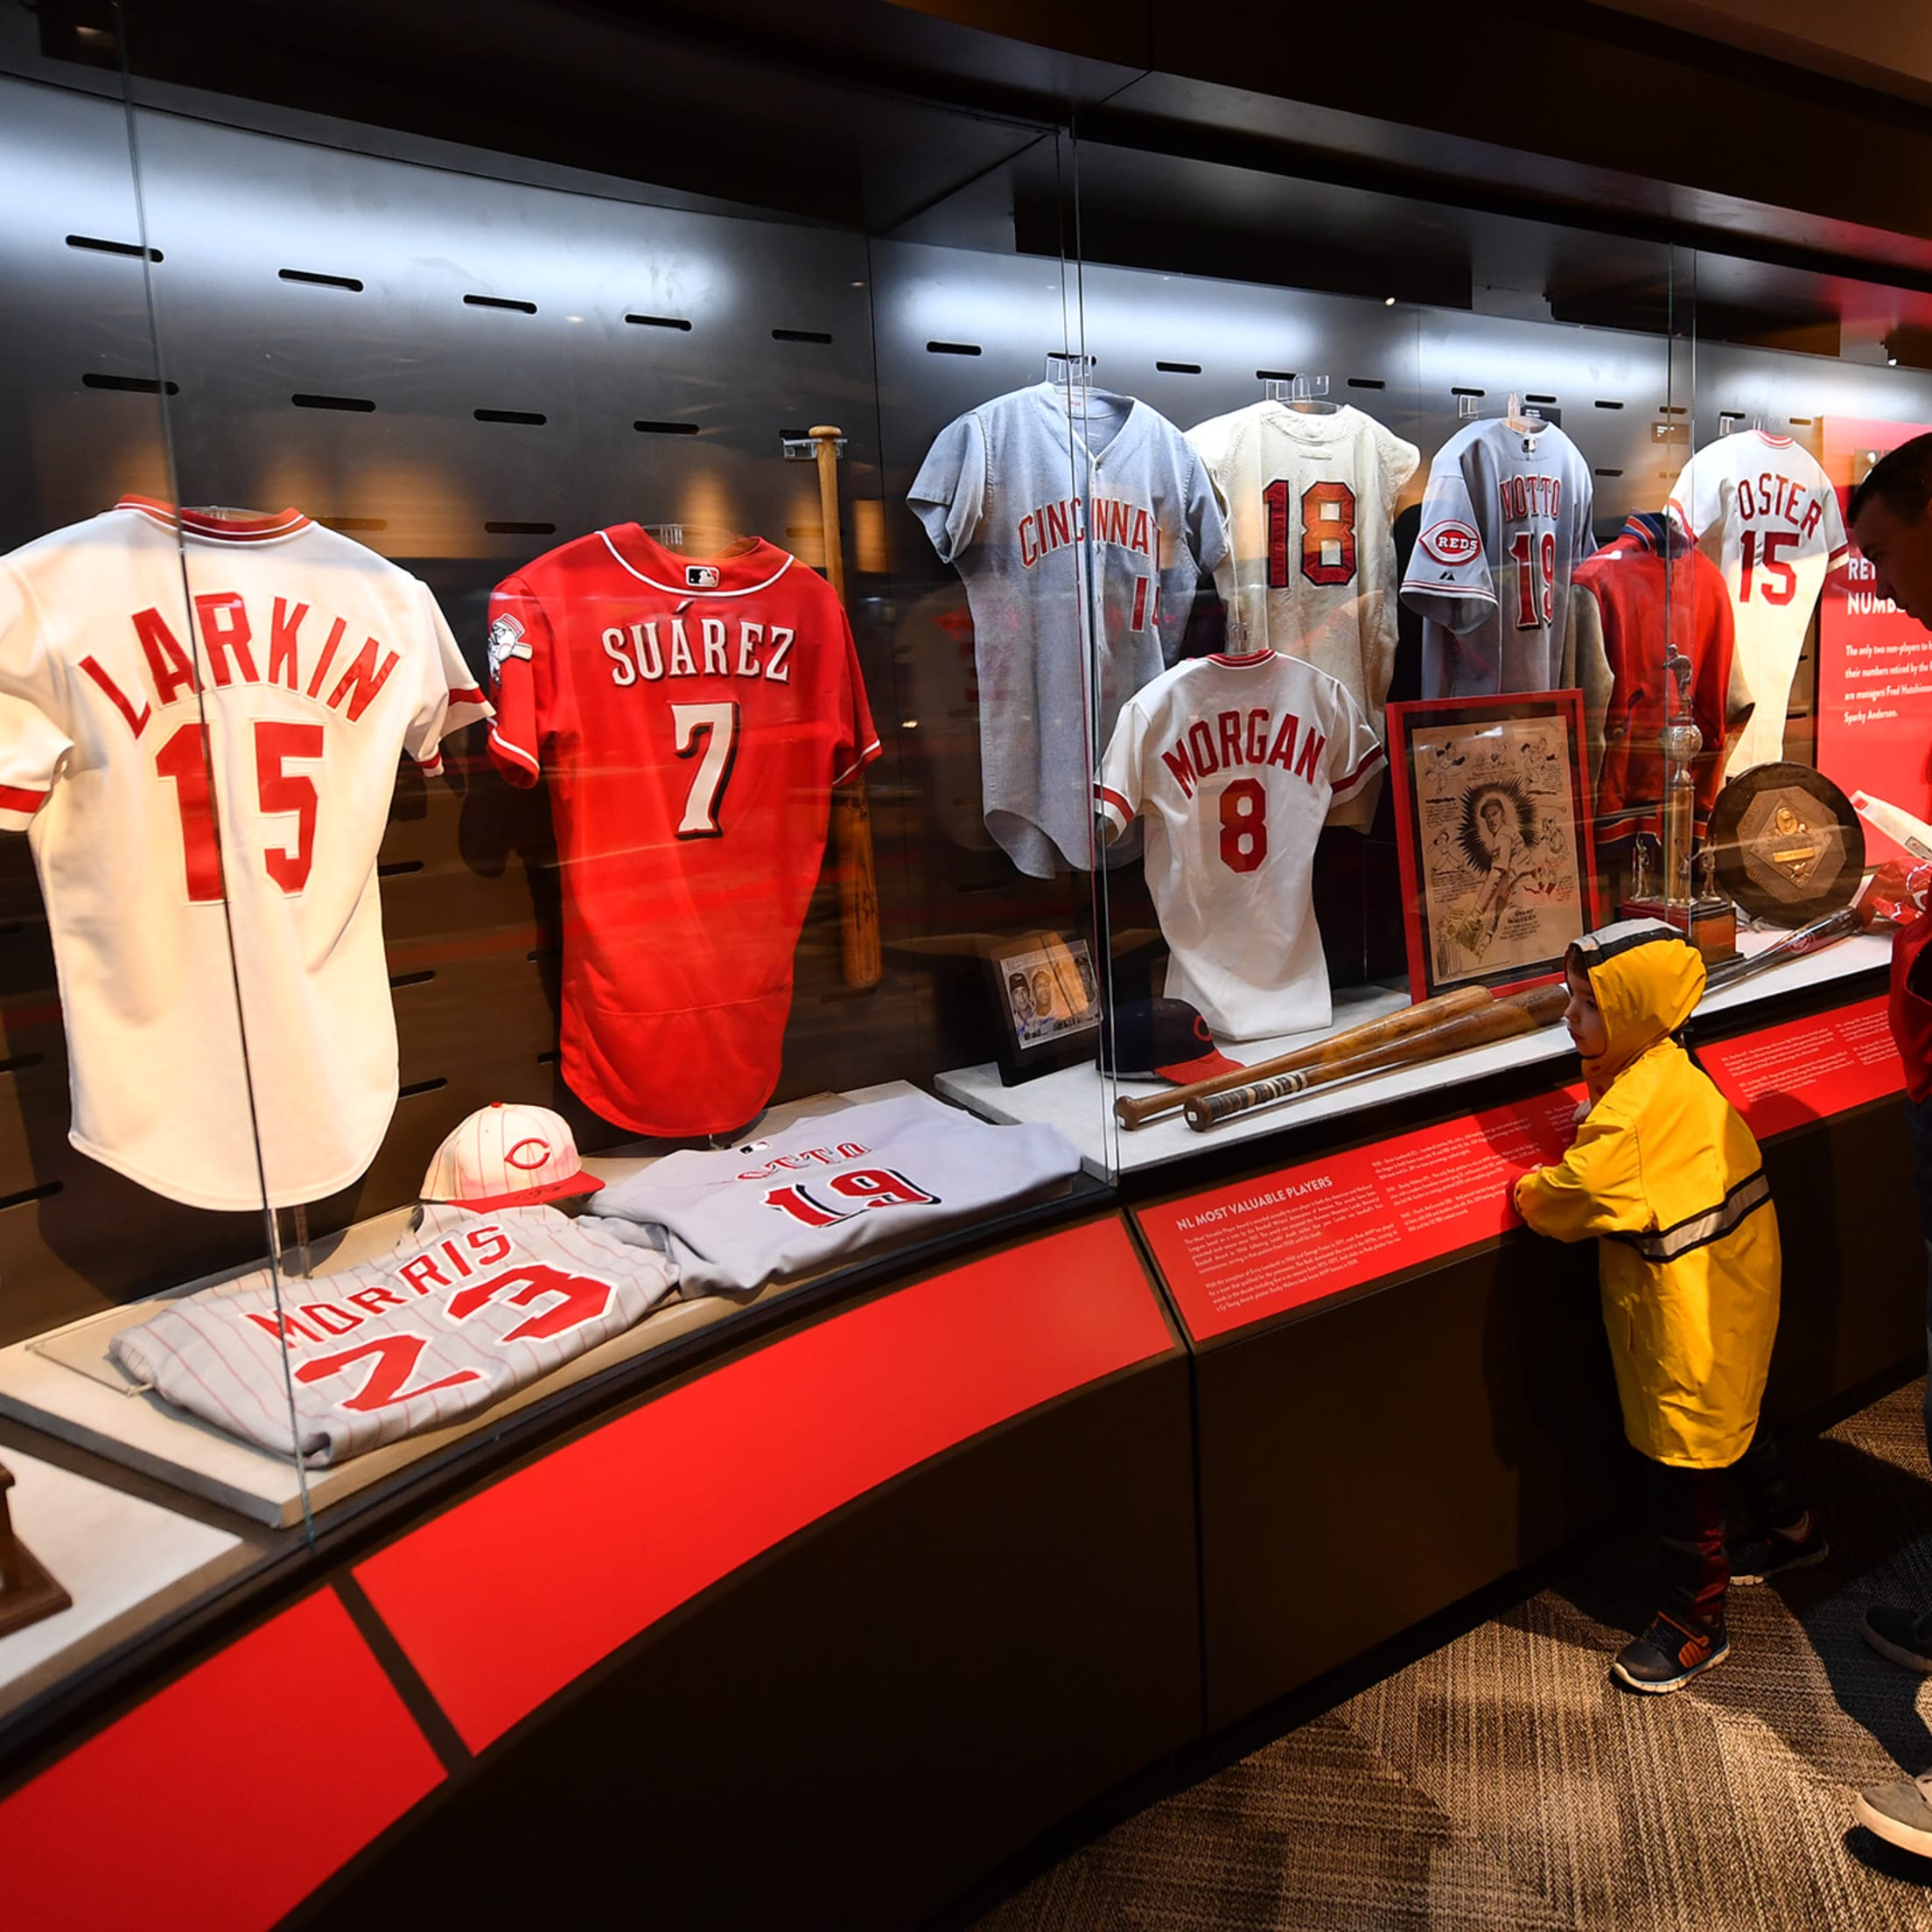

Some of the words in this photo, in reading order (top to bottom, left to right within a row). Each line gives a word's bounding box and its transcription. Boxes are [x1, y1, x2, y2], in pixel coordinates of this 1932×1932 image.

[1018, 496, 1162, 570] CINCINNA
[1262, 479, 1357, 588] 18
[1500, 475, 1562, 522] VOTTO
[1737, 472, 1824, 540] OSTER
[1438, 536, 1479, 551] REDS
[1508, 531, 1556, 631] 19
[1739, 529, 1801, 606] 15
[78, 591, 401, 740] LARKIN
[602, 600, 795, 686] SUÁREZ
[1861, 665, 1888, 677] numbers
[1161, 708, 1326, 800] MORGAN
[1844, 710, 1866, 726] Sparky
[667, 701, 740, 841] 7
[155, 719, 326, 904] 15
[1218, 777, 1269, 874] 8
[504, 1137, 550, 1171] C
[708, 1141, 872, 1186] OTTO
[759, 1168, 942, 1228] 19
[1176, 1218, 1194, 1232] NL
[1194, 1204, 1229, 1225] MOST
[1229, 1189, 1287, 1214] VALUABLE
[1287, 1175, 1334, 1199] PLAYERS
[244, 1223, 514, 1349] MORRIS
[295, 1263, 614, 1412] 23
